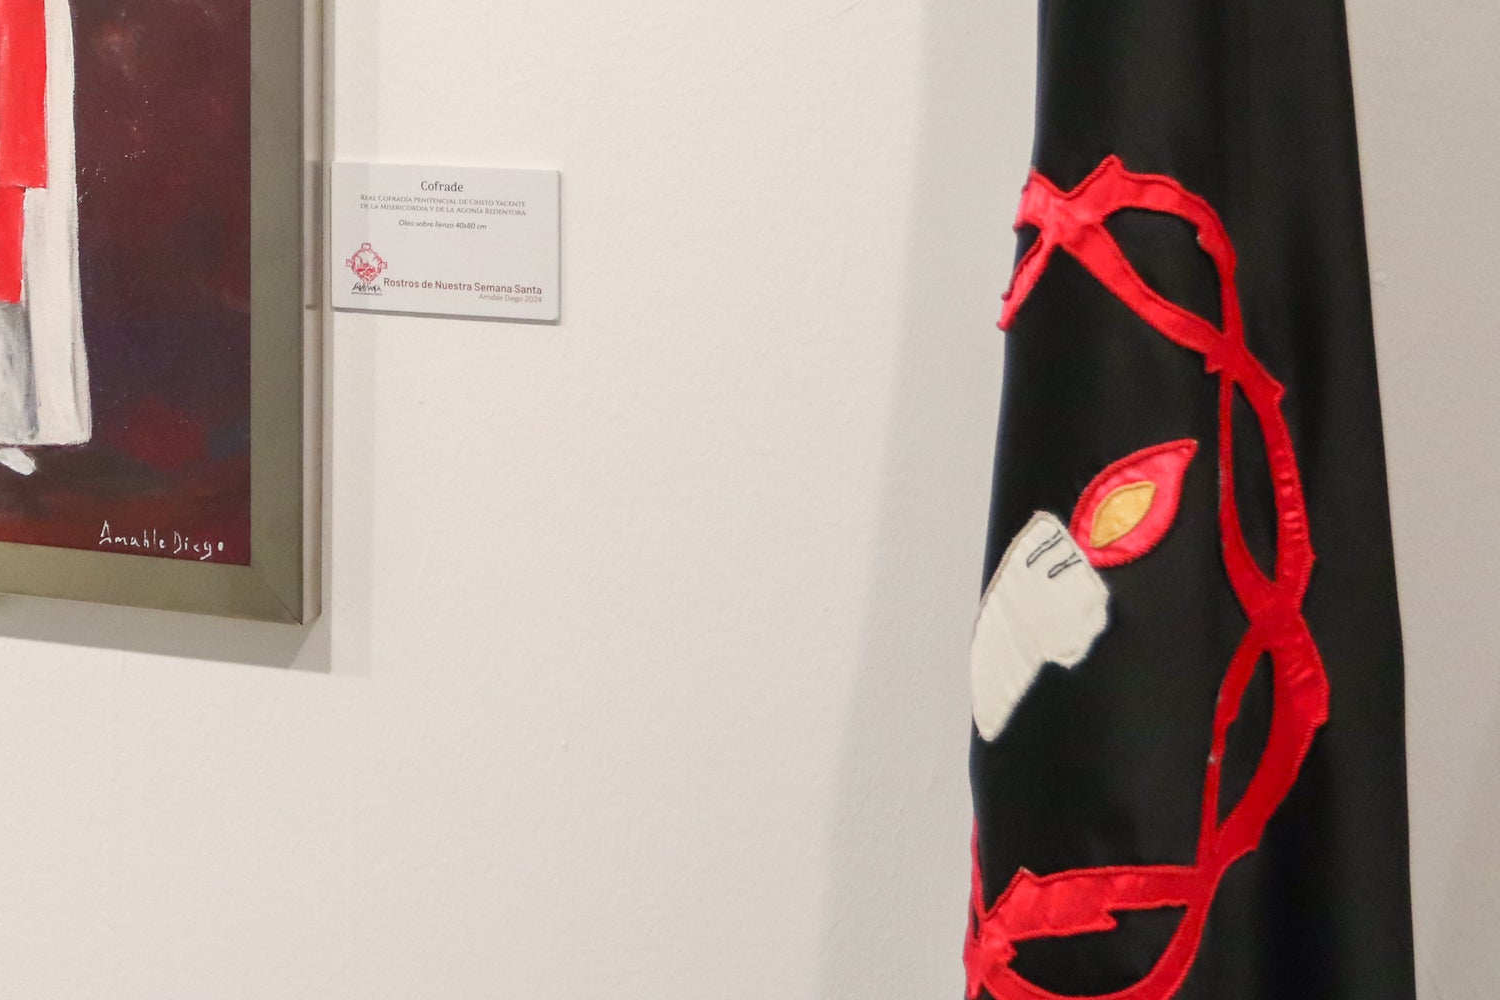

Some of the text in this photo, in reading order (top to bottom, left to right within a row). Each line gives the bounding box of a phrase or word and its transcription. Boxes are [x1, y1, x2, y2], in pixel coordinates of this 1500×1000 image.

[421, 180, 464, 192] Cofrade
[416, 219, 433, 228] sobre
[383, 278, 420, 289] Rostros
[421, 280, 433, 289] de
[435, 280, 472, 291] Nuestra
[474, 282, 512, 293] Semana
[514, 284, 542, 295] Santa
[479, 293, 542, 303] Amable Diego 2024
